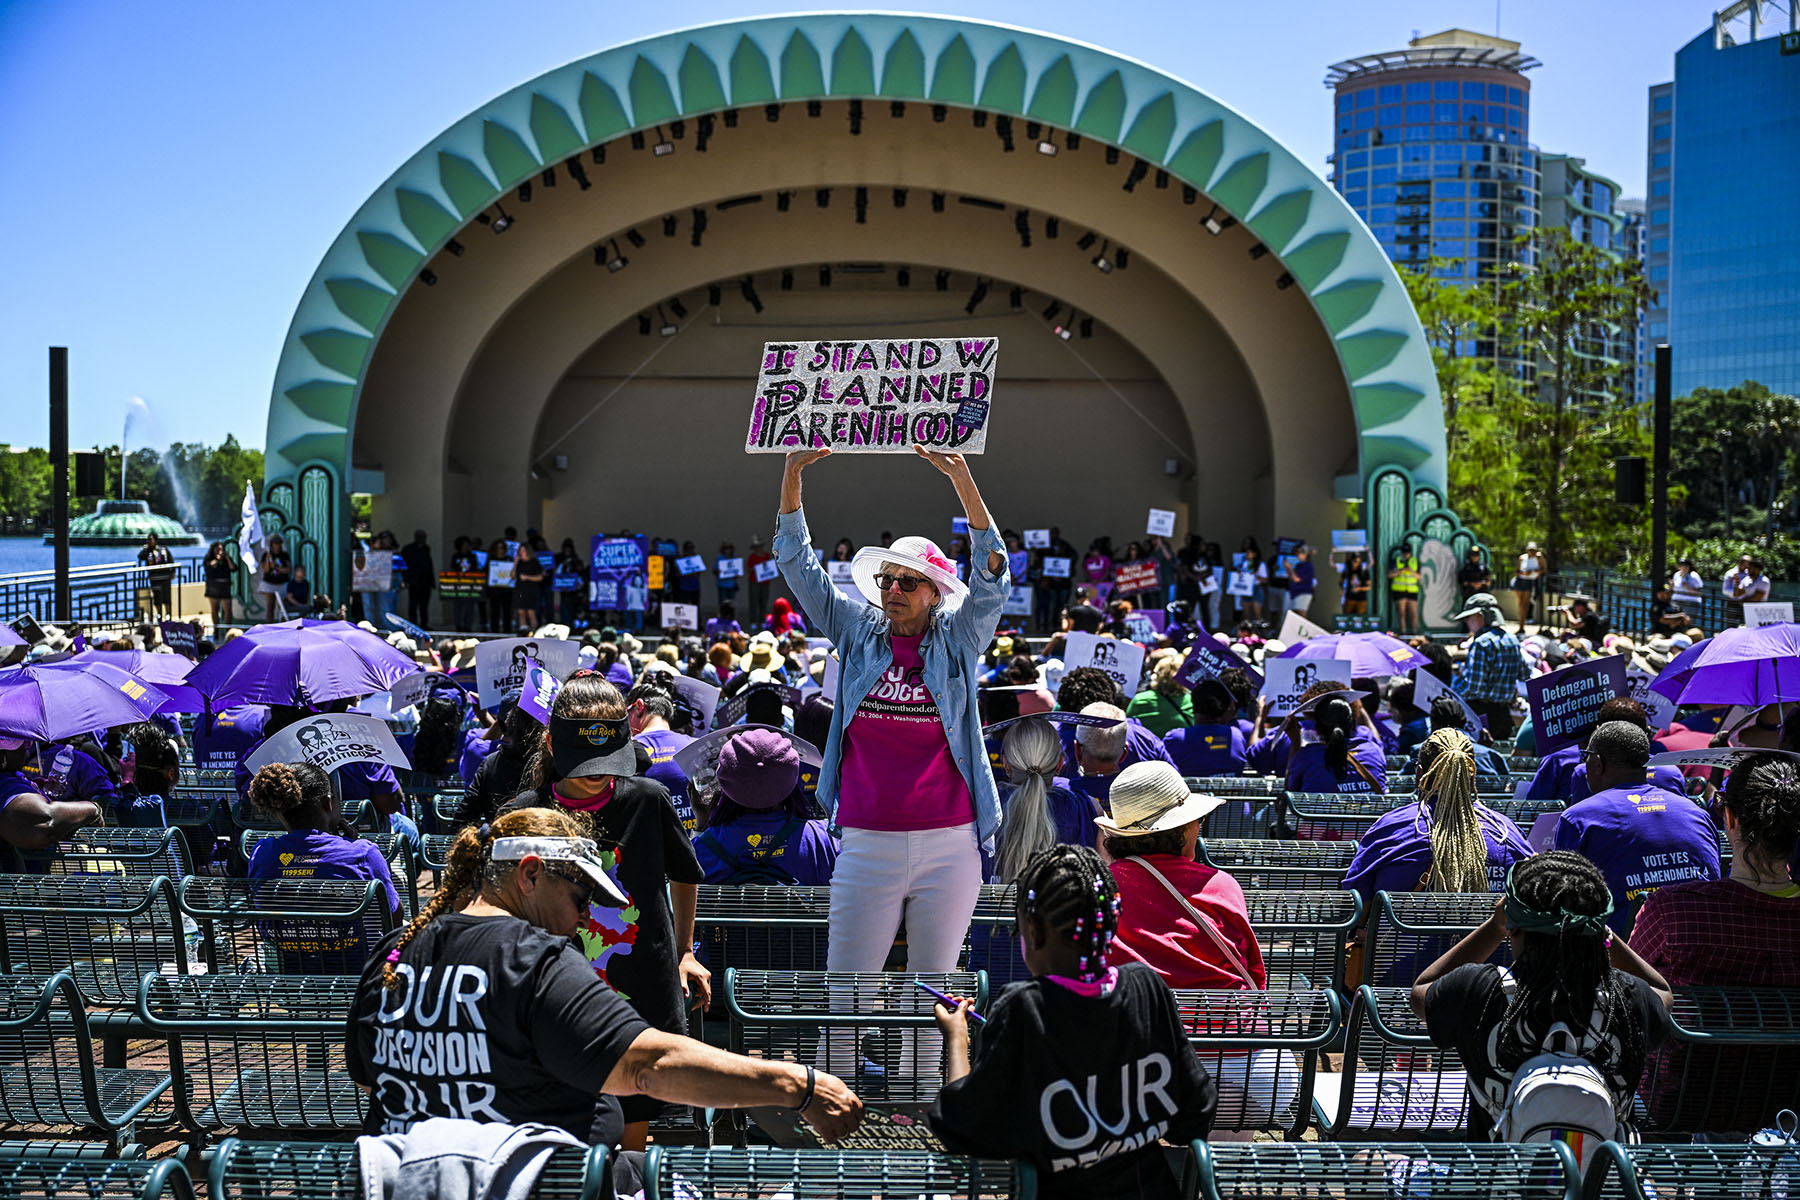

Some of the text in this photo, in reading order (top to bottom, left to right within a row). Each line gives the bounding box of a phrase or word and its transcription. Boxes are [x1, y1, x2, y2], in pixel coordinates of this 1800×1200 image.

[764, 339, 998, 375] I STAND W/
[763, 371, 990, 417] PLANNED
[758, 404, 978, 448] PARENTHOOD
[600, 544, 636, 558] SUPER
[1198, 646, 1220, 664] Stop
[1542, 672, 1610, 703] Detengan la
[1541, 688, 1616, 721] interferencia
[579, 728, 616, 737] Hard Rock
[1546, 710, 1600, 738] del gobier
[210, 752, 223, 760] VOTE
[1337, 782, 1356, 792] VOTE
[672, 796, 682, 806] ES
[682, 820, 696, 830] 202
[1642, 852, 1690, 868] VOTE YES
[1485, 866, 1505, 878] YES
[1626, 866, 1710, 887] ON AMENDMENT 4
[376, 963, 490, 1031] OUR
[372, 1026, 491, 1077] DECISION
[376, 1072, 512, 1124] OUR
[1040, 1052, 1178, 1150] OUR
[840, 1138, 926, 1150] DERECHOS
